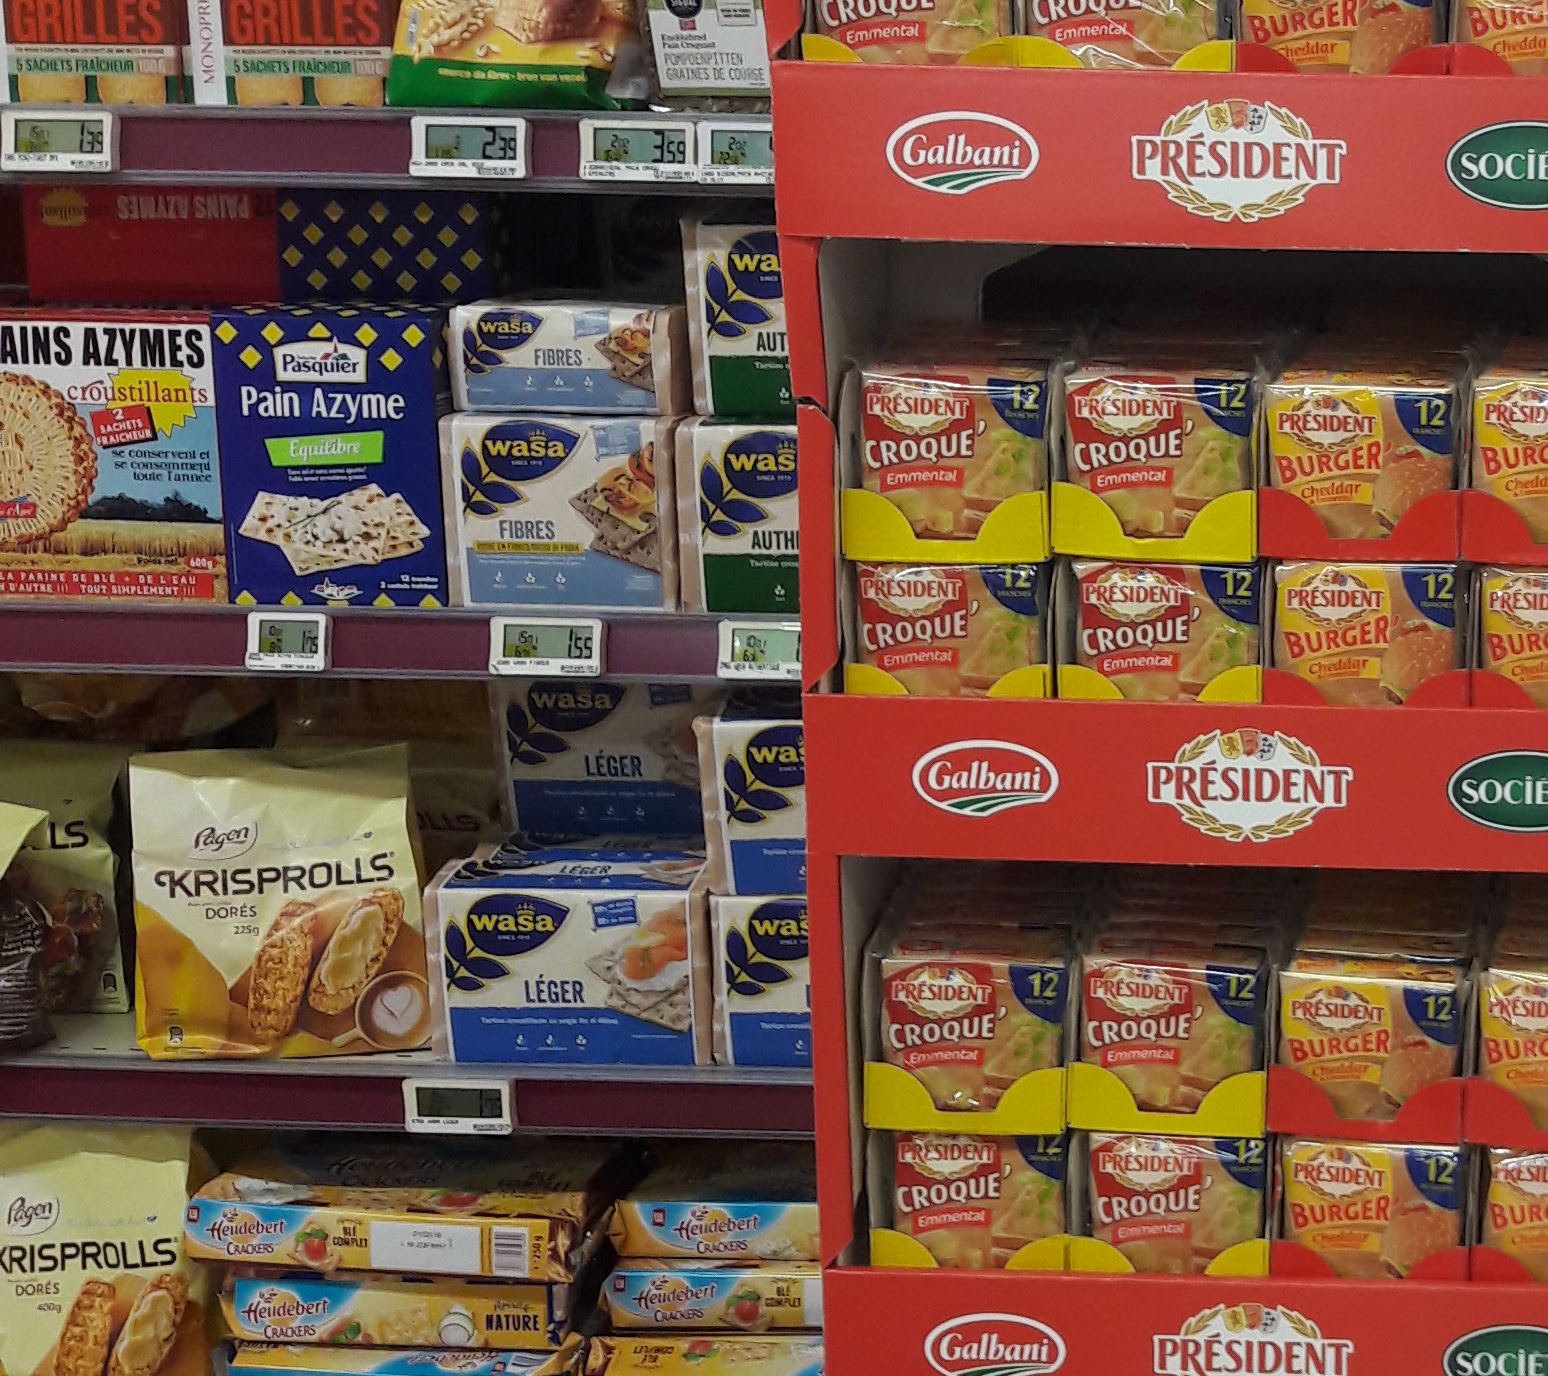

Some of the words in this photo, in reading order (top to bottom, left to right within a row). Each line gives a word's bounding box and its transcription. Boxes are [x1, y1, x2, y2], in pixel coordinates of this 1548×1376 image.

[845, 23, 920, 45] Emmental
[902, 133, 1021, 169] Galbani
[1136, 130, 1344, 185] PRÉSIDENT
[480, 319, 534, 335] wasa
[0, 326, 71, 366] AINS
[83, 326, 205, 368] AZYMES
[534, 349, 582, 367] FIBRES
[282, 354, 359, 376] Pasquier
[67, 379, 208, 404] croustillants
[113, 409, 125, 420] 2
[240, 386, 300, 418] Pain
[312, 387, 405, 424] Azyme
[1413, 400, 1447, 427] 12
[100, 420, 143, 435] SACHETS
[289, 439, 361, 463] Equilibre
[485, 438, 565, 459] wasa
[886, 468, 959, 486] Emmental
[1300, 481, 1362, 505] Cheddar
[499, 520, 555, 540] FIBRES
[1220, 572, 1253, 598] 12
[1286, 586, 1385, 611] PRÉSIDENT
[1103, 654, 1174, 672] Emmental
[531, 687, 613, 711] wasa
[585, 751, 643, 778] LÉGER
[928, 760, 1042, 794] Galbani
[1150, 760, 1350, 810] PRÉSIDENT
[154, 852, 395, 899] KRISPROLLS
[205, 903, 257, 920] DORÉS
[470, 911, 556, 933] wasa
[524, 975, 585, 1004] LÉGER
[1029, 971, 1058, 998] 12
[205, 1219, 285, 1243] Heudebert
[226, 1242, 275, 1256] CRACKERS
[16, 1280, 60, 1296] DORÉS
[241, 1298, 329, 1324] Heudebert
[485, 1313, 540, 1333] NATURE
[263, 1324, 317, 1339] CRACKERS
[938, 1332, 1051, 1366] Galbani
